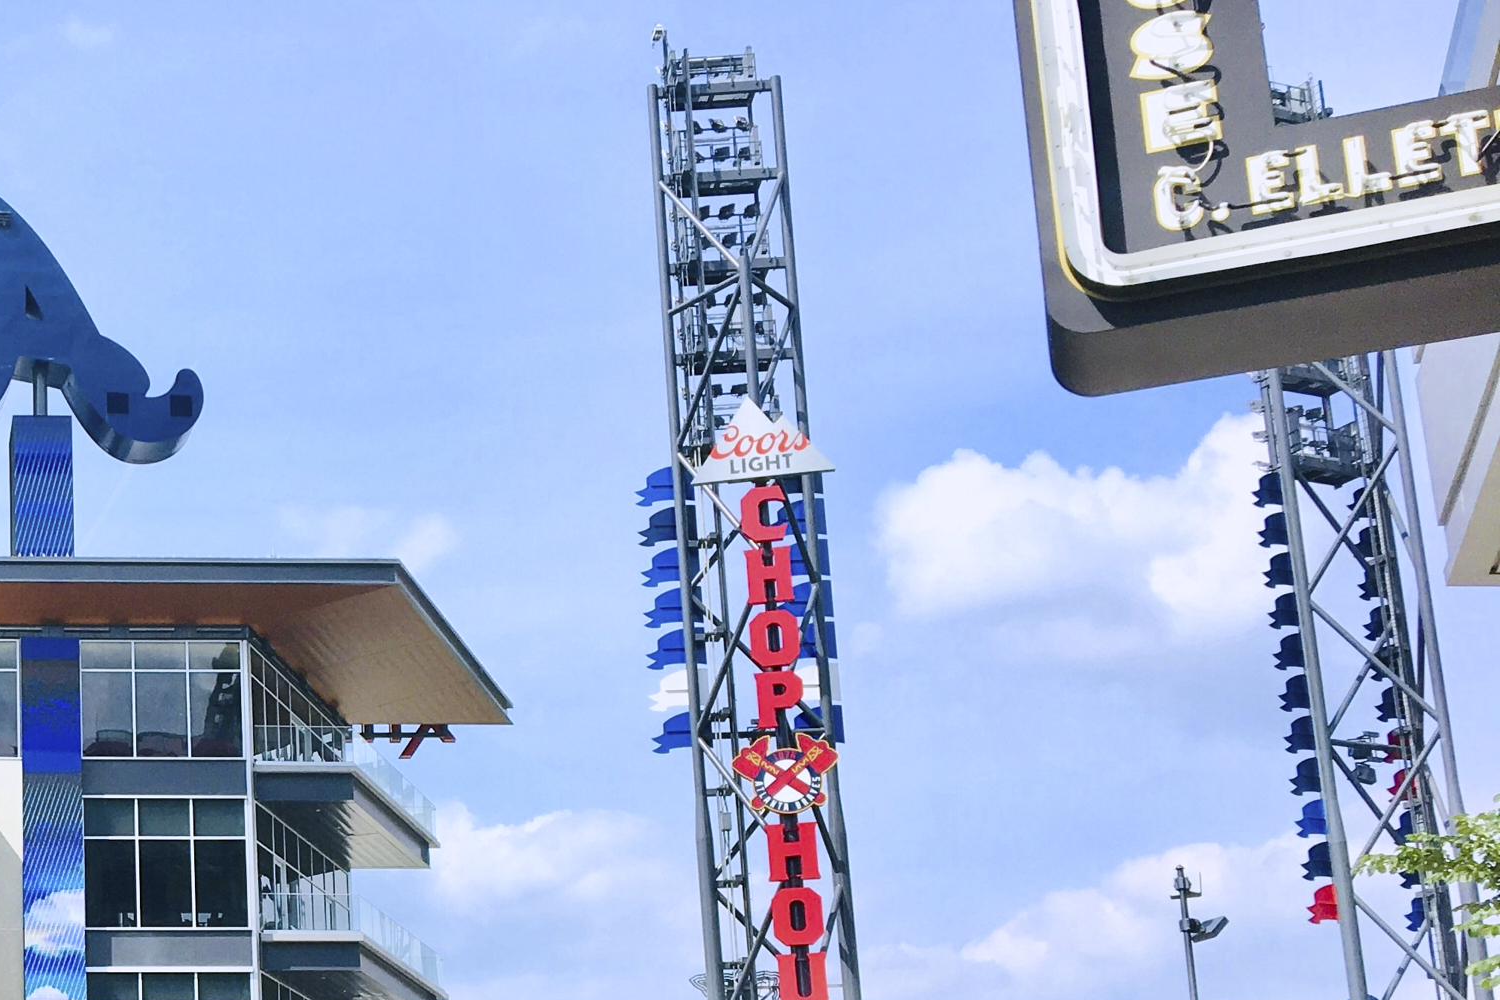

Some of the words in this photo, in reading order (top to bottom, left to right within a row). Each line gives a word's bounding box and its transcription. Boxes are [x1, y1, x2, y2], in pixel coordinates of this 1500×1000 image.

[1129, 0, 1223, 154] SE
[1153, 165, 1230, 231] C.
[1245, 107, 1500, 215] ELLET
[709, 425, 811, 460] Coors
[730, 452, 793, 475] LIGHT
[740, 485, 803, 729] CHOP
